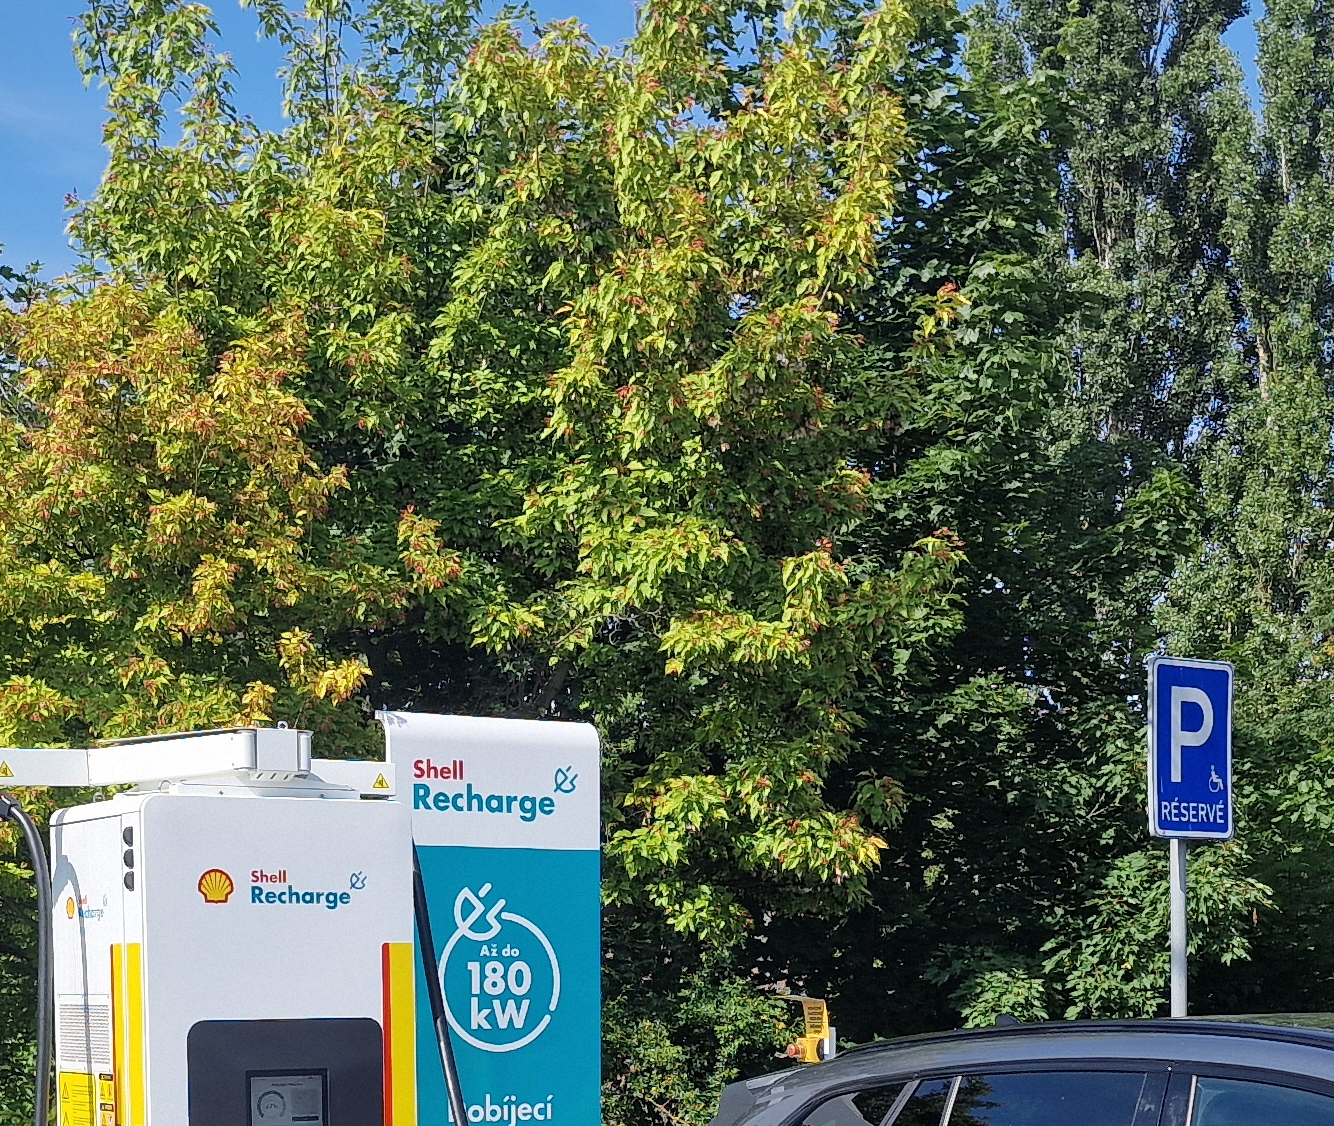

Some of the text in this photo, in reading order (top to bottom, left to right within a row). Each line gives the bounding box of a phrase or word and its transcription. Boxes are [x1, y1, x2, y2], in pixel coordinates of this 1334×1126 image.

[1170, 685, 1214, 783] P
[413, 759, 464, 780] Shell
[413, 783, 556, 822] Recharge
[1161, 797, 1225, 823] RÉSERVÉ
[250, 869, 287, 883] Shell
[250, 885, 351, 910] Recharge
[479, 943, 520, 957] Až do
[467, 961, 532, 996] 180
[470, 996, 531, 1030] kW
